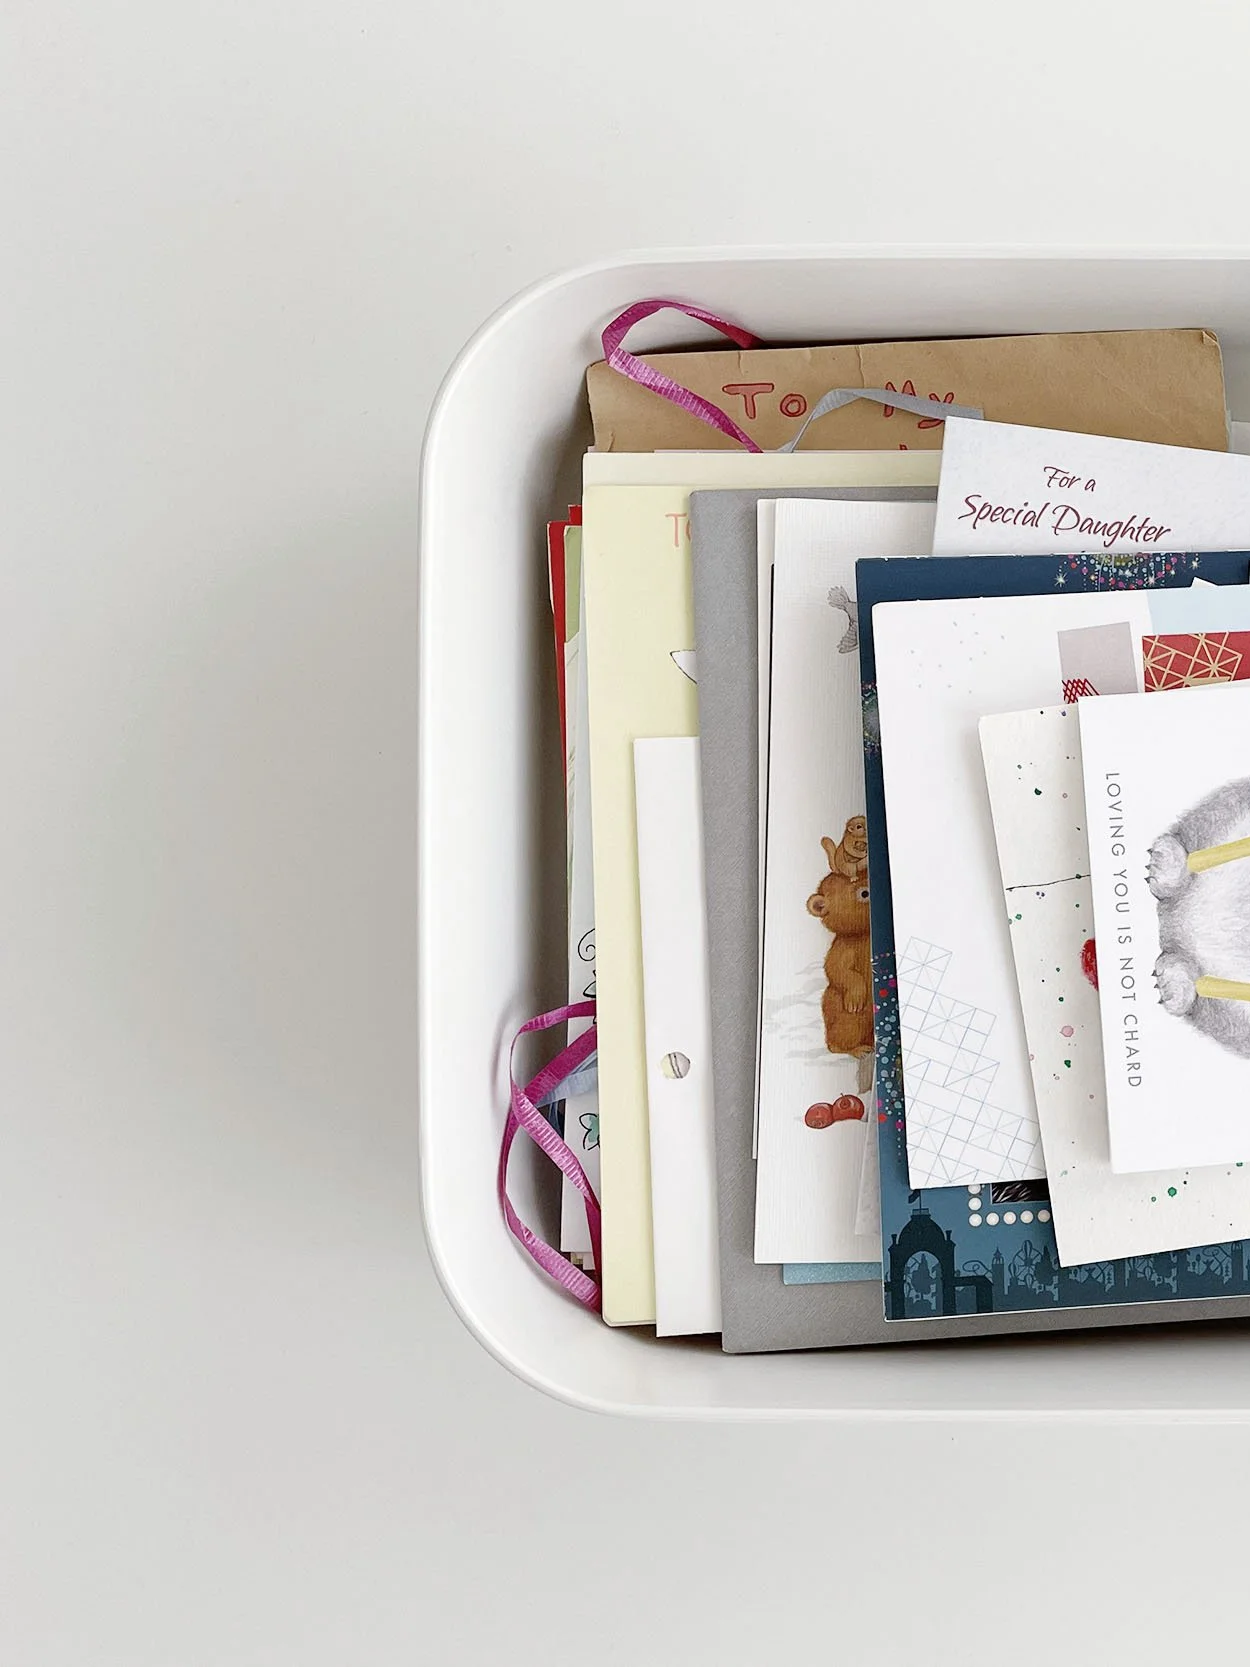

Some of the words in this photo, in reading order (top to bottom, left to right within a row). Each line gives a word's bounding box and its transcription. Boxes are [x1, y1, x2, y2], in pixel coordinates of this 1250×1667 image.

[722, 382, 807, 420] To
[1043, 466, 1081, 488] For
[1084, 476, 1097, 492] a
[958, 494, 1051, 530] Special
[1051, 504, 1172, 548] Daughter
[1105, 772, 1126, 857] LOVING
[1113, 869, 1130, 913] YOU
[1117, 926, 1132, 944] IS
[1119, 957, 1136, 1001] NOT
[1123, 1014, 1142, 1087] CHARD
